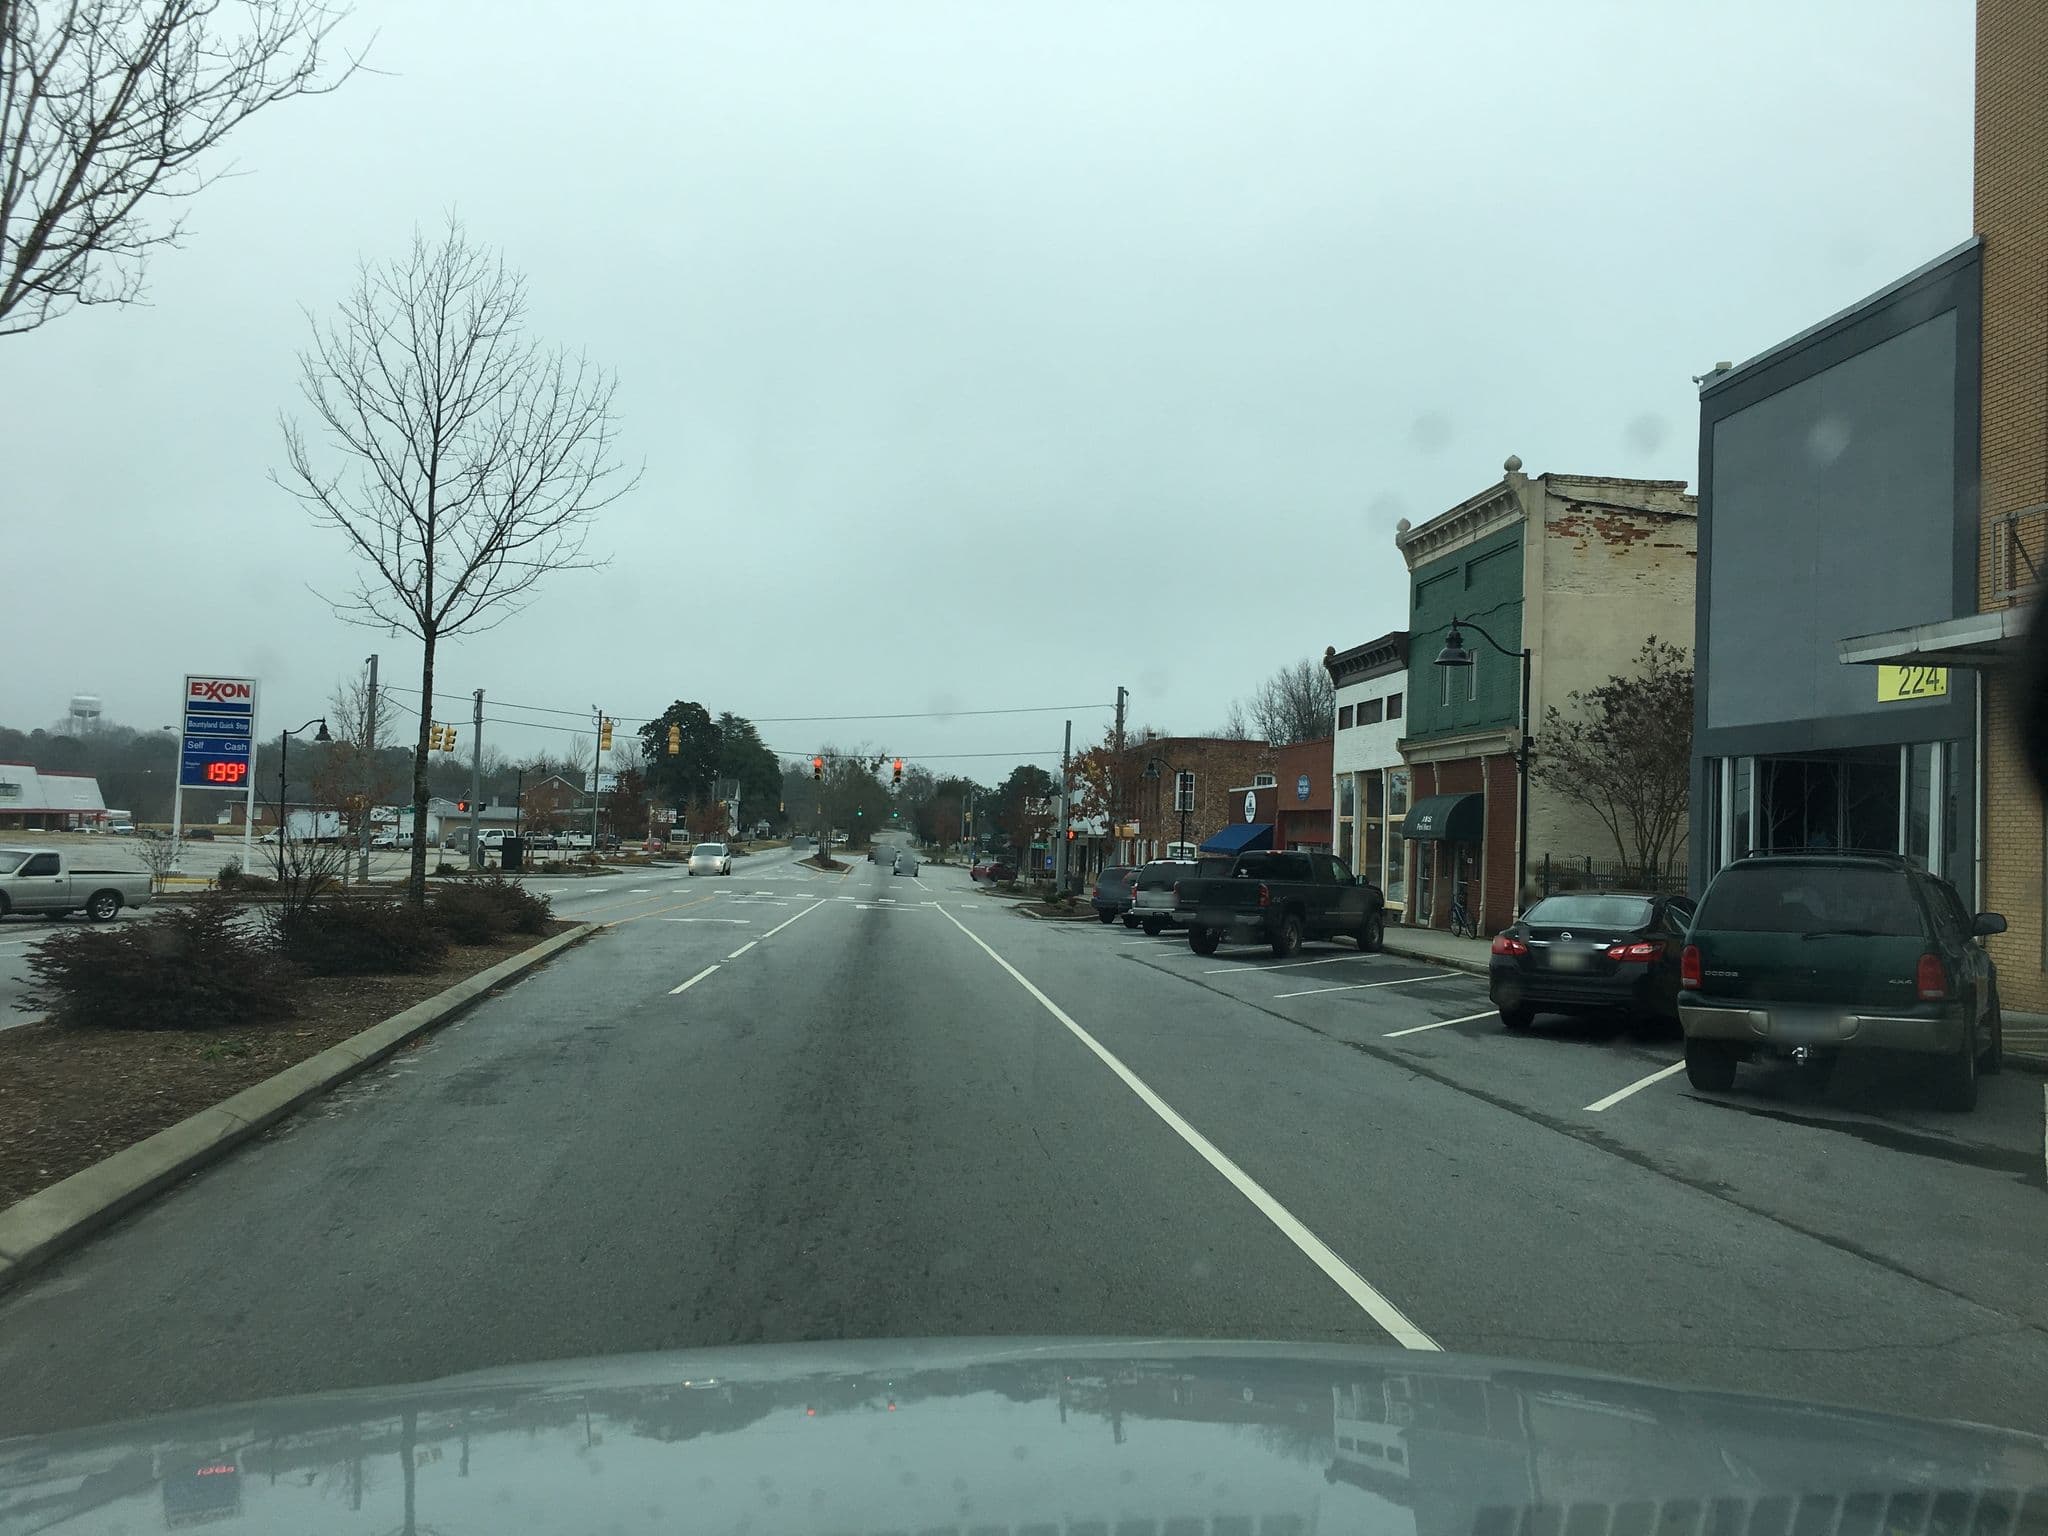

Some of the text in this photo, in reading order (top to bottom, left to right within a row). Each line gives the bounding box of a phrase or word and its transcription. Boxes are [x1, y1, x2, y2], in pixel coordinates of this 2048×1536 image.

[191, 681, 250, 703] EXXON
[188, 720, 249, 731] Bountyland Quick Stop
[187, 740, 204, 749] Self
[224, 742, 247, 751] Cash
